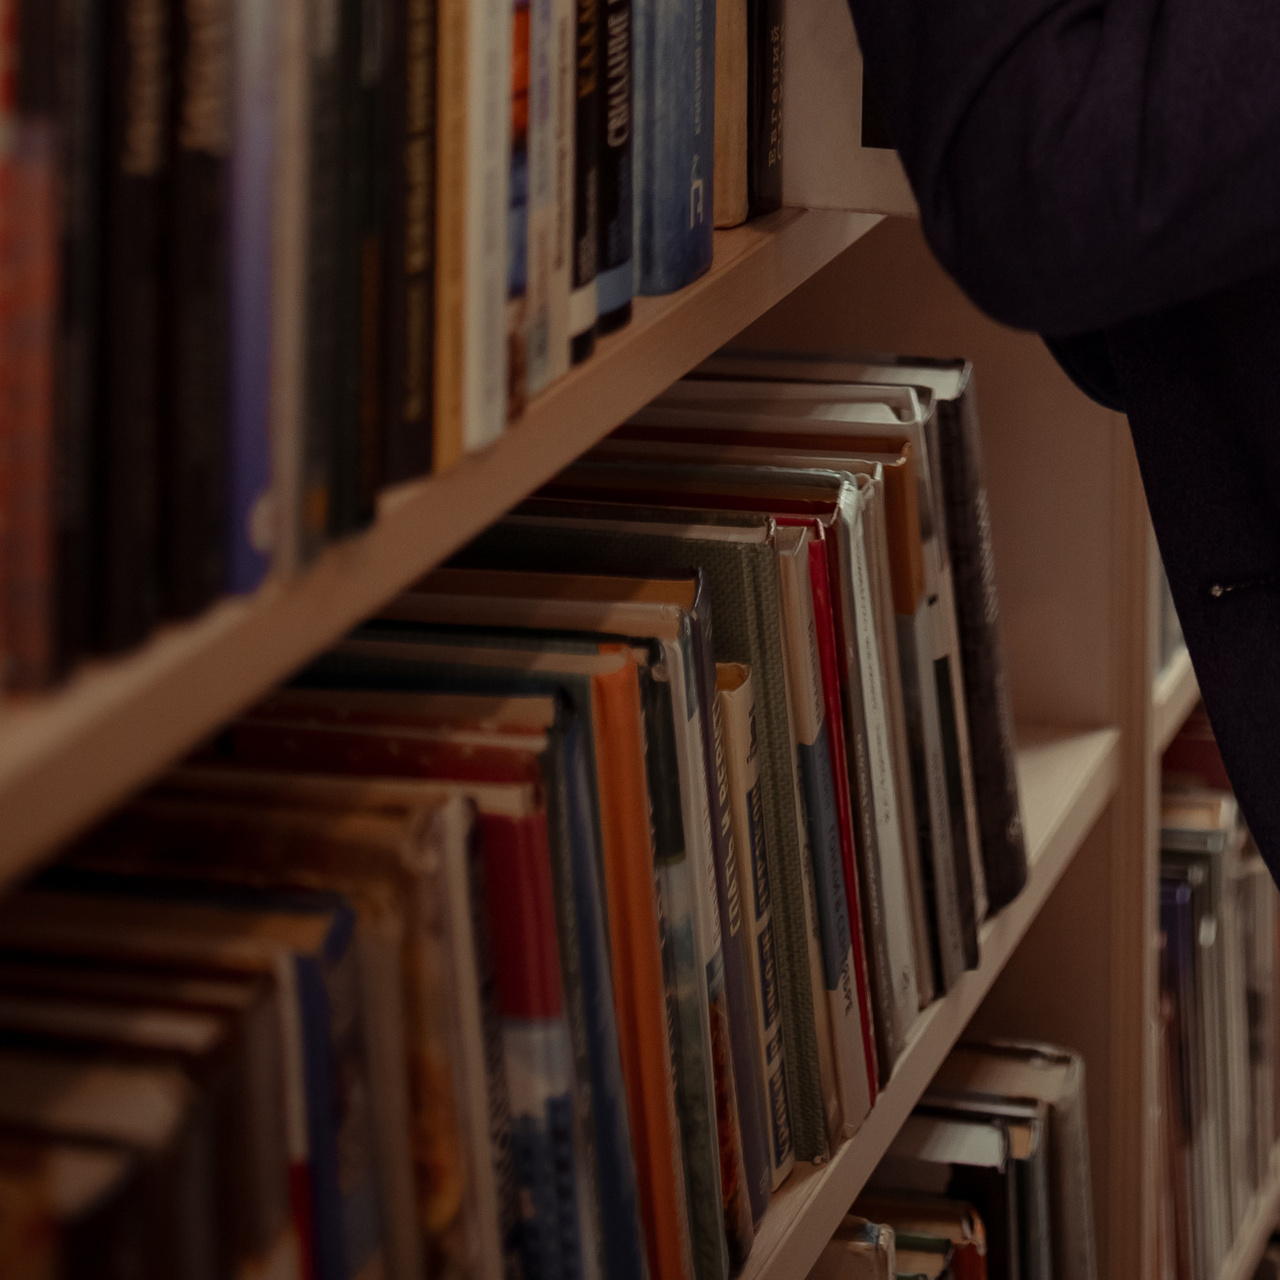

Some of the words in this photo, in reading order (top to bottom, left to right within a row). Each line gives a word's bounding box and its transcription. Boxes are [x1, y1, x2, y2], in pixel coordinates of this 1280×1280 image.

[607, 10, 629, 147] СВИДАНИЕ
[768, 23, 779, 168] Евгений
[724, 834, 740, 936] СПАТЬ
